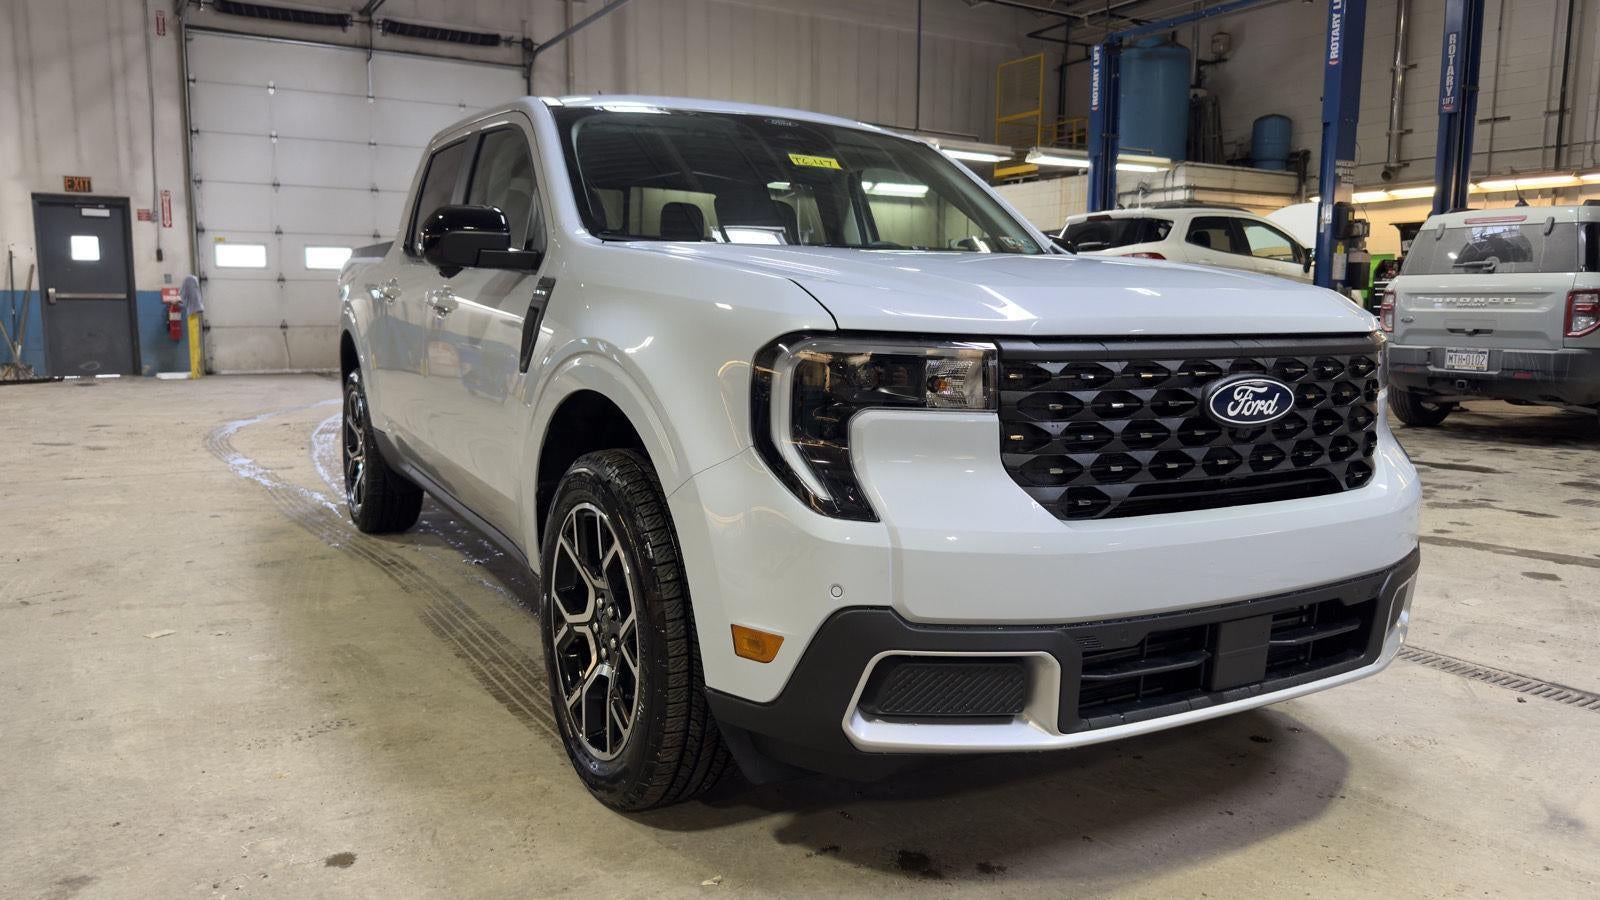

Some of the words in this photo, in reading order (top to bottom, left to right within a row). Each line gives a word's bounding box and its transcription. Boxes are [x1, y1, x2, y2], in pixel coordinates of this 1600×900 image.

[1330, 13, 1341, 59] ROTARY
[1093, 45, 1101, 66] LIFT
[1446, 33, 1457, 97] ROTARY
[1092, 68, 1100, 106] ROTARY
[1442, 97, 1454, 106] LIFT
[64, 176, 92, 193] EXIT
[1227, 385, 1280, 417] Ford
